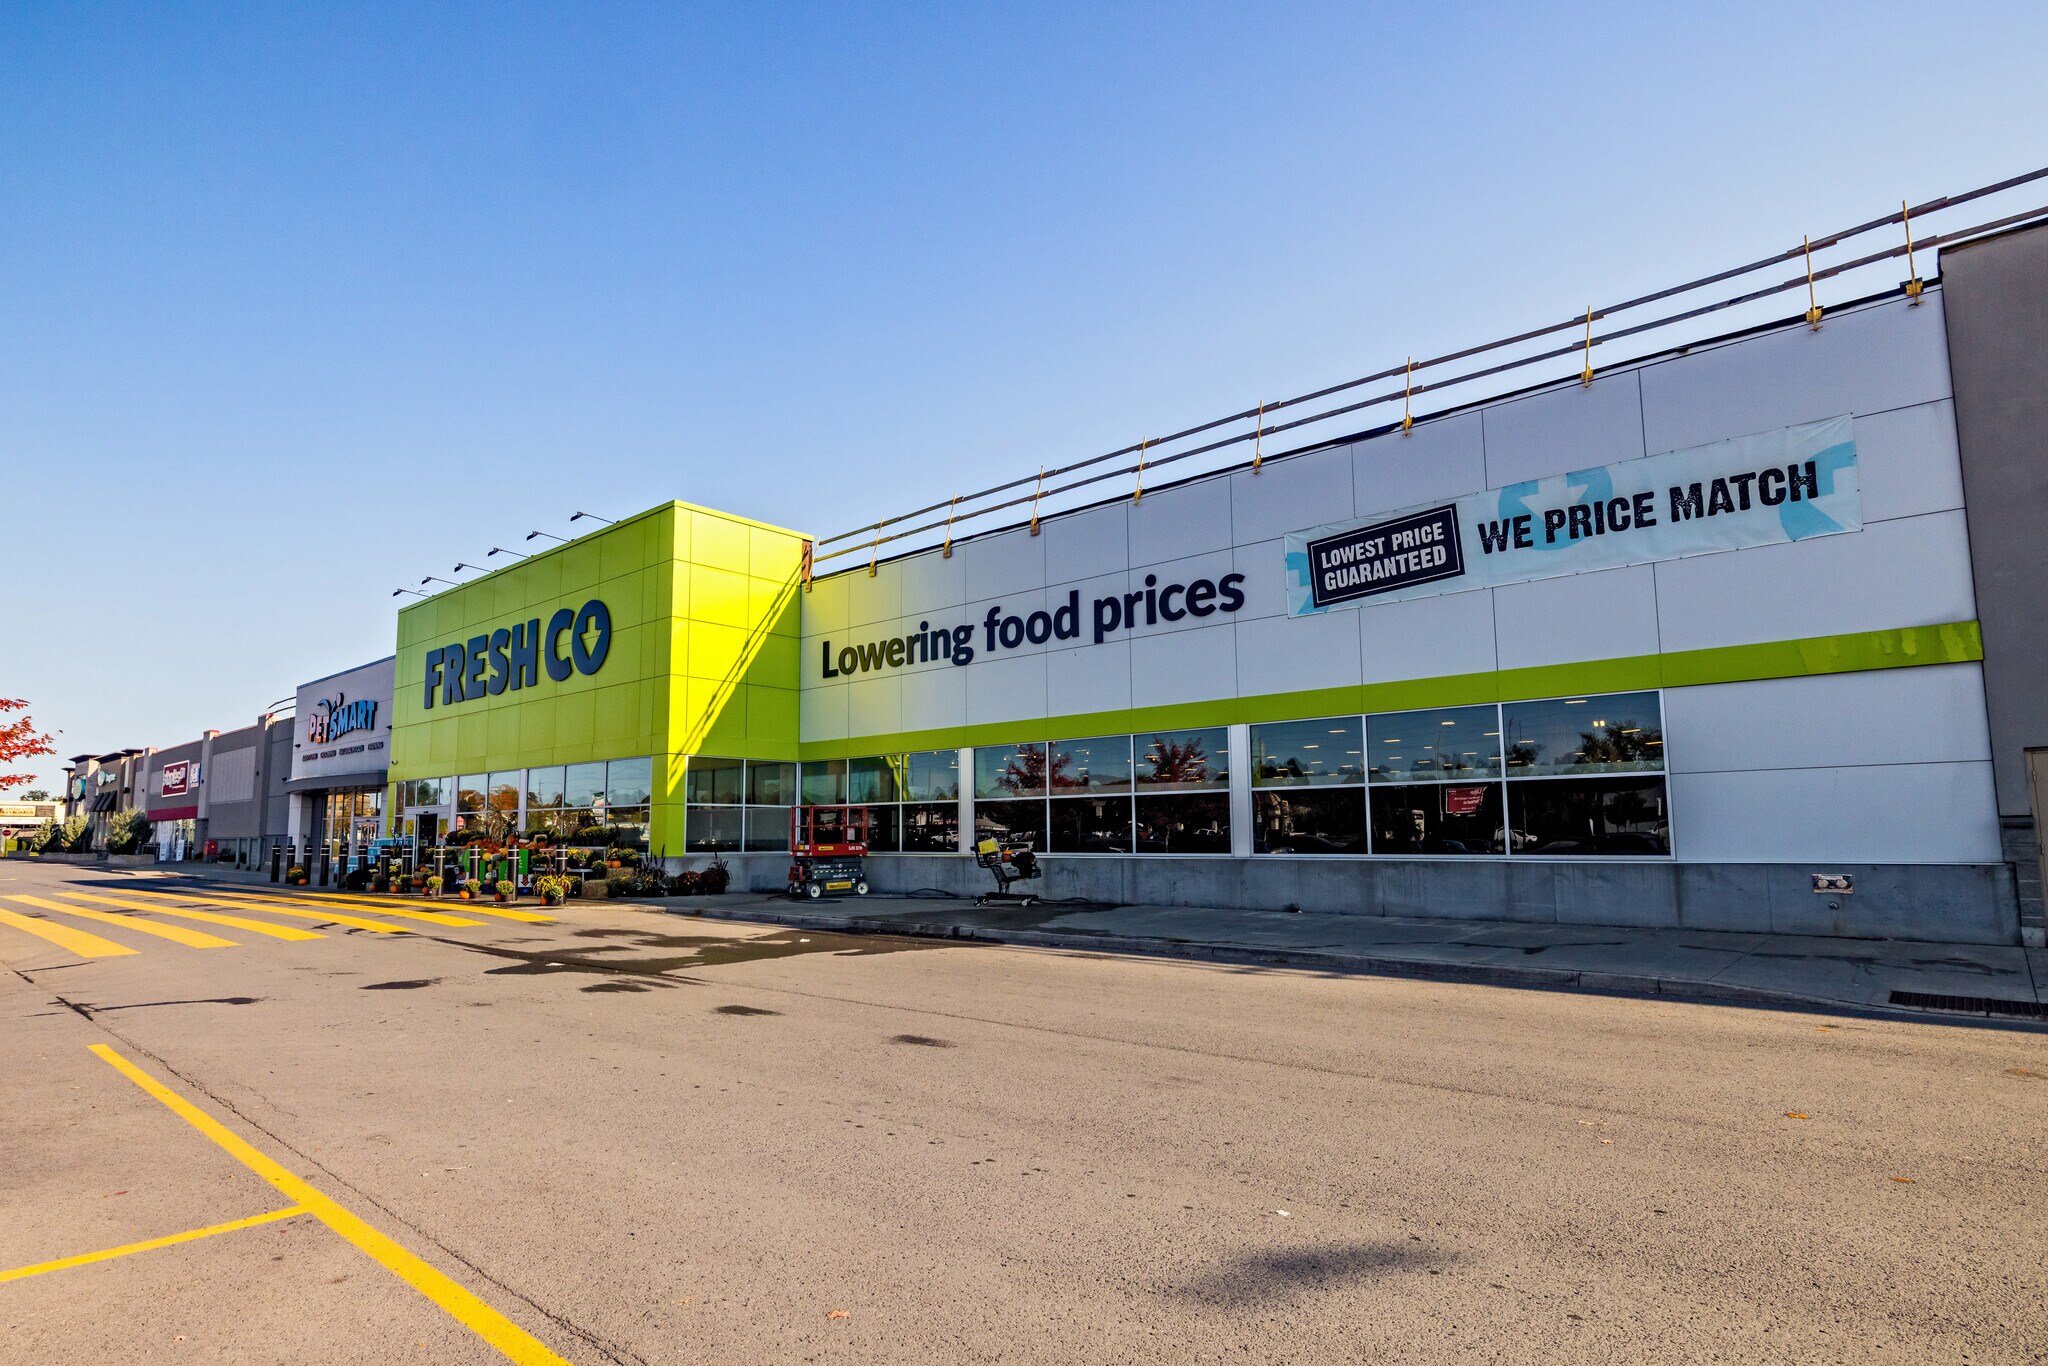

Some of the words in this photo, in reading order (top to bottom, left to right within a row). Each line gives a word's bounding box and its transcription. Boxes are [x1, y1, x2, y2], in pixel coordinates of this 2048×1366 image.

[1477, 513, 1534, 555] WE
[1544, 491, 1657, 543] PRICE
[1668, 461, 1818, 523] MATCH
[1321, 537, 1385, 569] LOWEST
[1391, 522, 1445, 551] PRICE
[1324, 545, 1447, 591] GUARANTEED
[822, 621, 974, 678] Lowering
[984, 589, 1080, 651] food
[1093, 573, 1246, 644] prices
